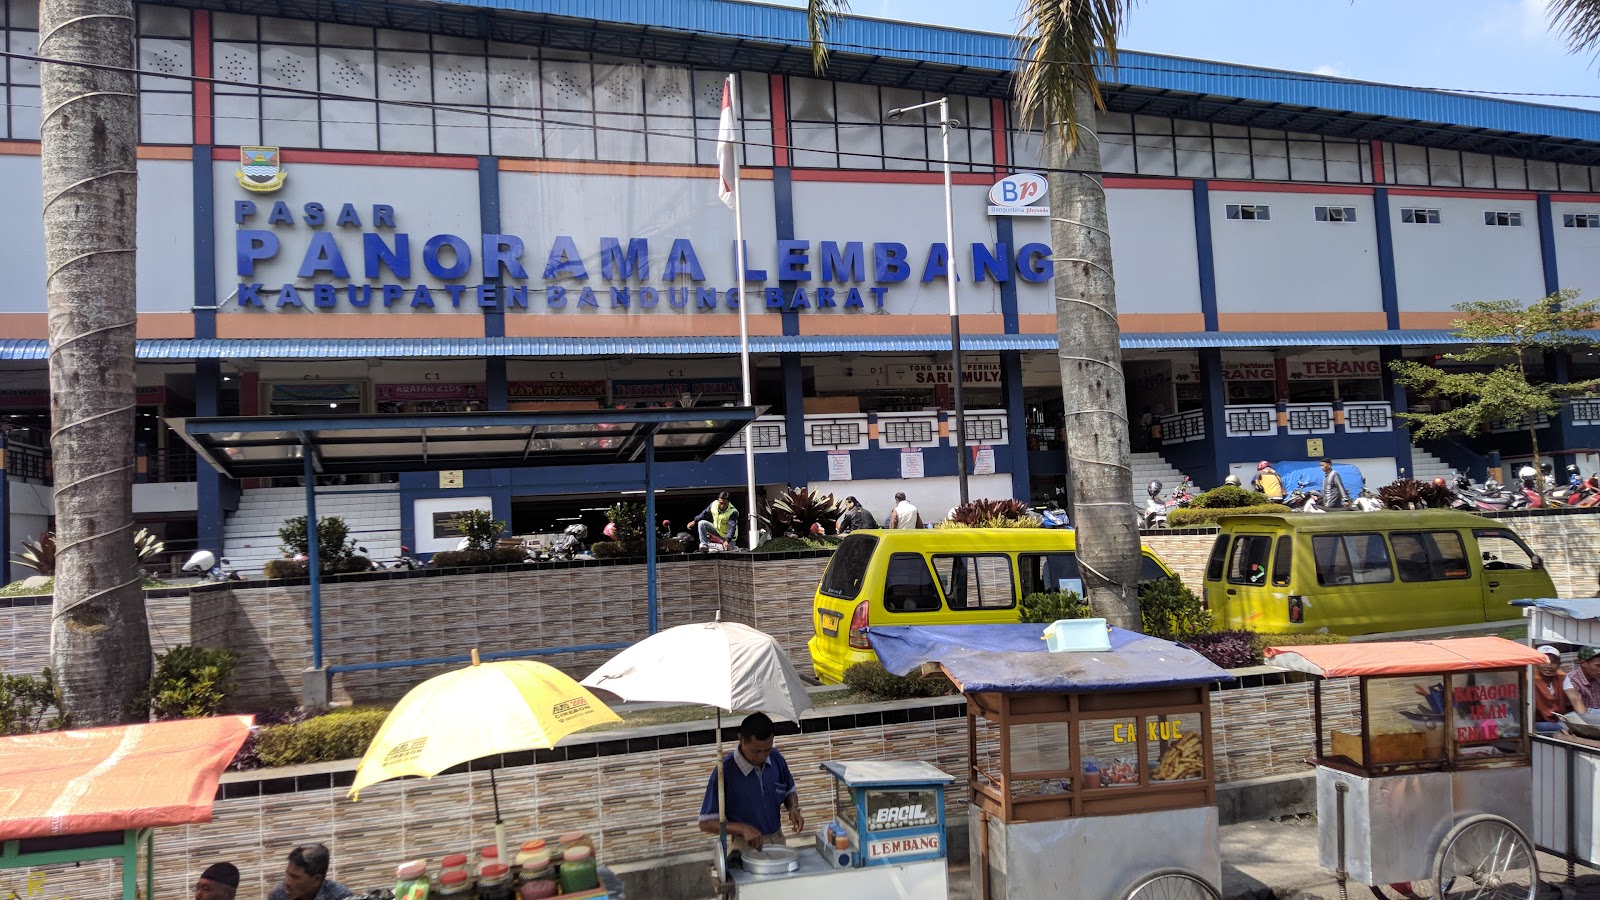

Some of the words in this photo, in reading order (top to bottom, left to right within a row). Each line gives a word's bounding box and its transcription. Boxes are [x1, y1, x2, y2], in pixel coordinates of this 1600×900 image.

[235, 200, 396, 228] PASAR
[236, 230, 706, 282] PANORAMA
[733, 239, 1054, 284] LEMBANG
[238, 283, 529, 309] KABUPATEN
[547, 284, 741, 309] BANDUNG
[766, 287, 888, 309] BARAT
[1191, 369, 1275, 380] TRANG
[1302, 360, 1380, 374] TERANG
[916, 372, 952, 383] SARI
[396, 385, 434, 393] ARAFAH
[437, 385, 462, 393] KIDS
[510, 386, 604, 396] PARAHYANGAN
[1453, 683, 1518, 703] BATAGOR
[1469, 703, 1508, 721] IKAN
[1148, 720, 1183, 741] KUE
[1457, 724, 1499, 744] ENAK
[876, 804, 927, 823] BACIL
[871, 836, 938, 856] LEMBANG
